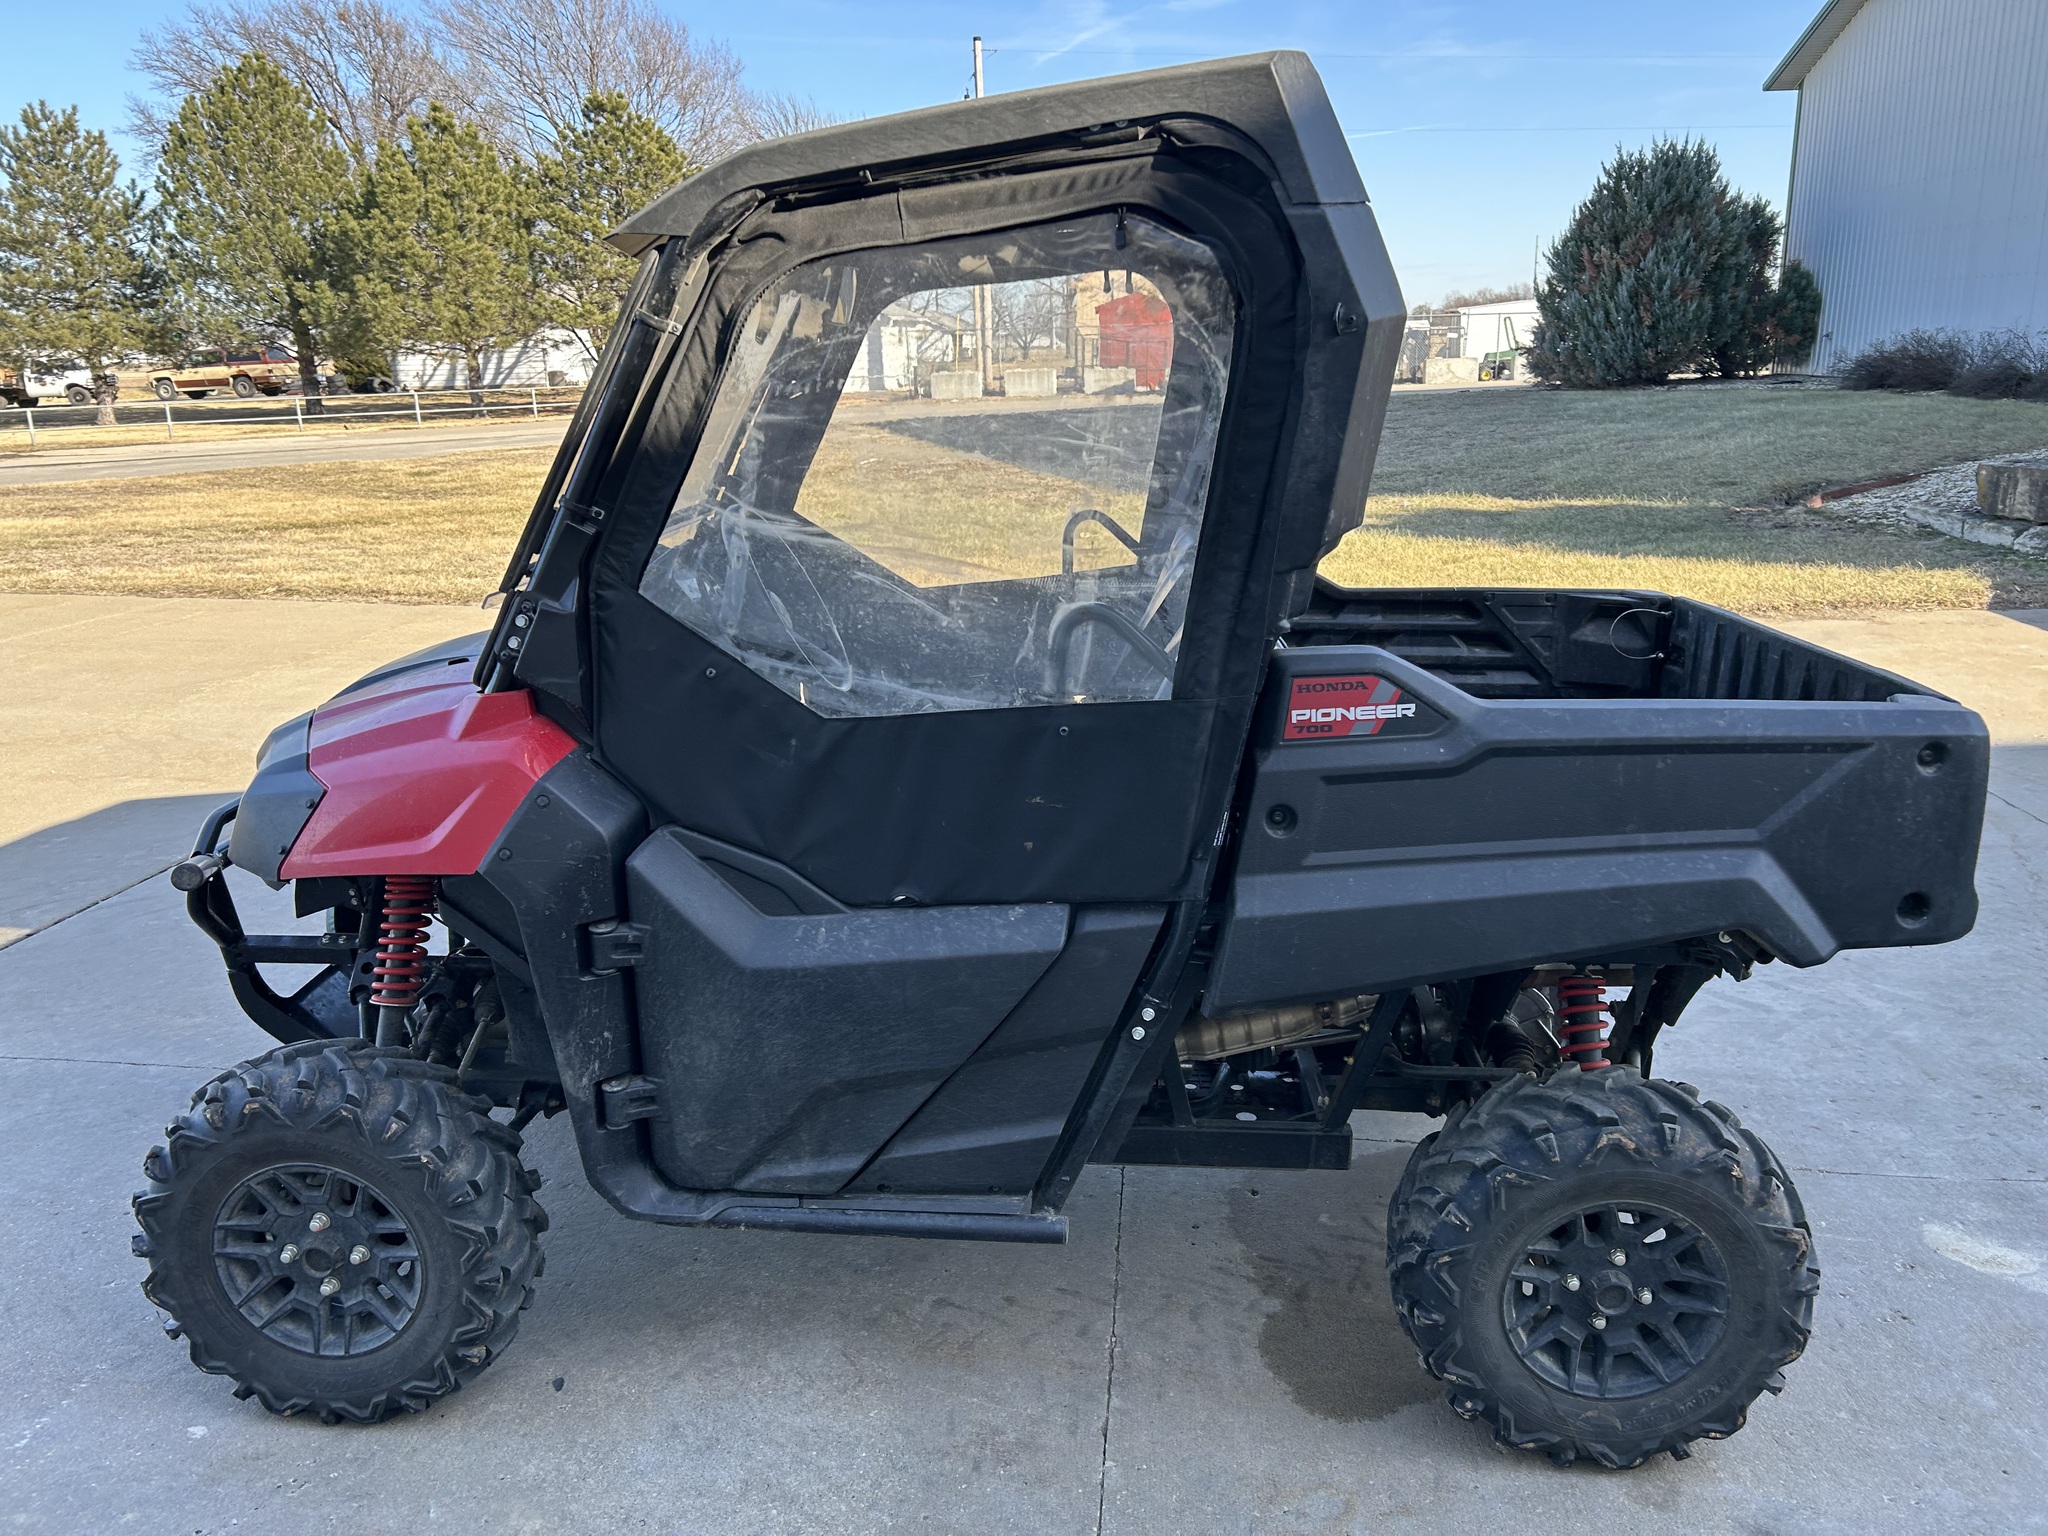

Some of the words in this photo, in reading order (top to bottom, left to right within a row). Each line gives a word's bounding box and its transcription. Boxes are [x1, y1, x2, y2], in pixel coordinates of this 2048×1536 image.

[1296, 681, 1368, 694] HONDA
[1291, 703, 1416, 724] PIONEER
[1293, 724, 1333, 734] 700
